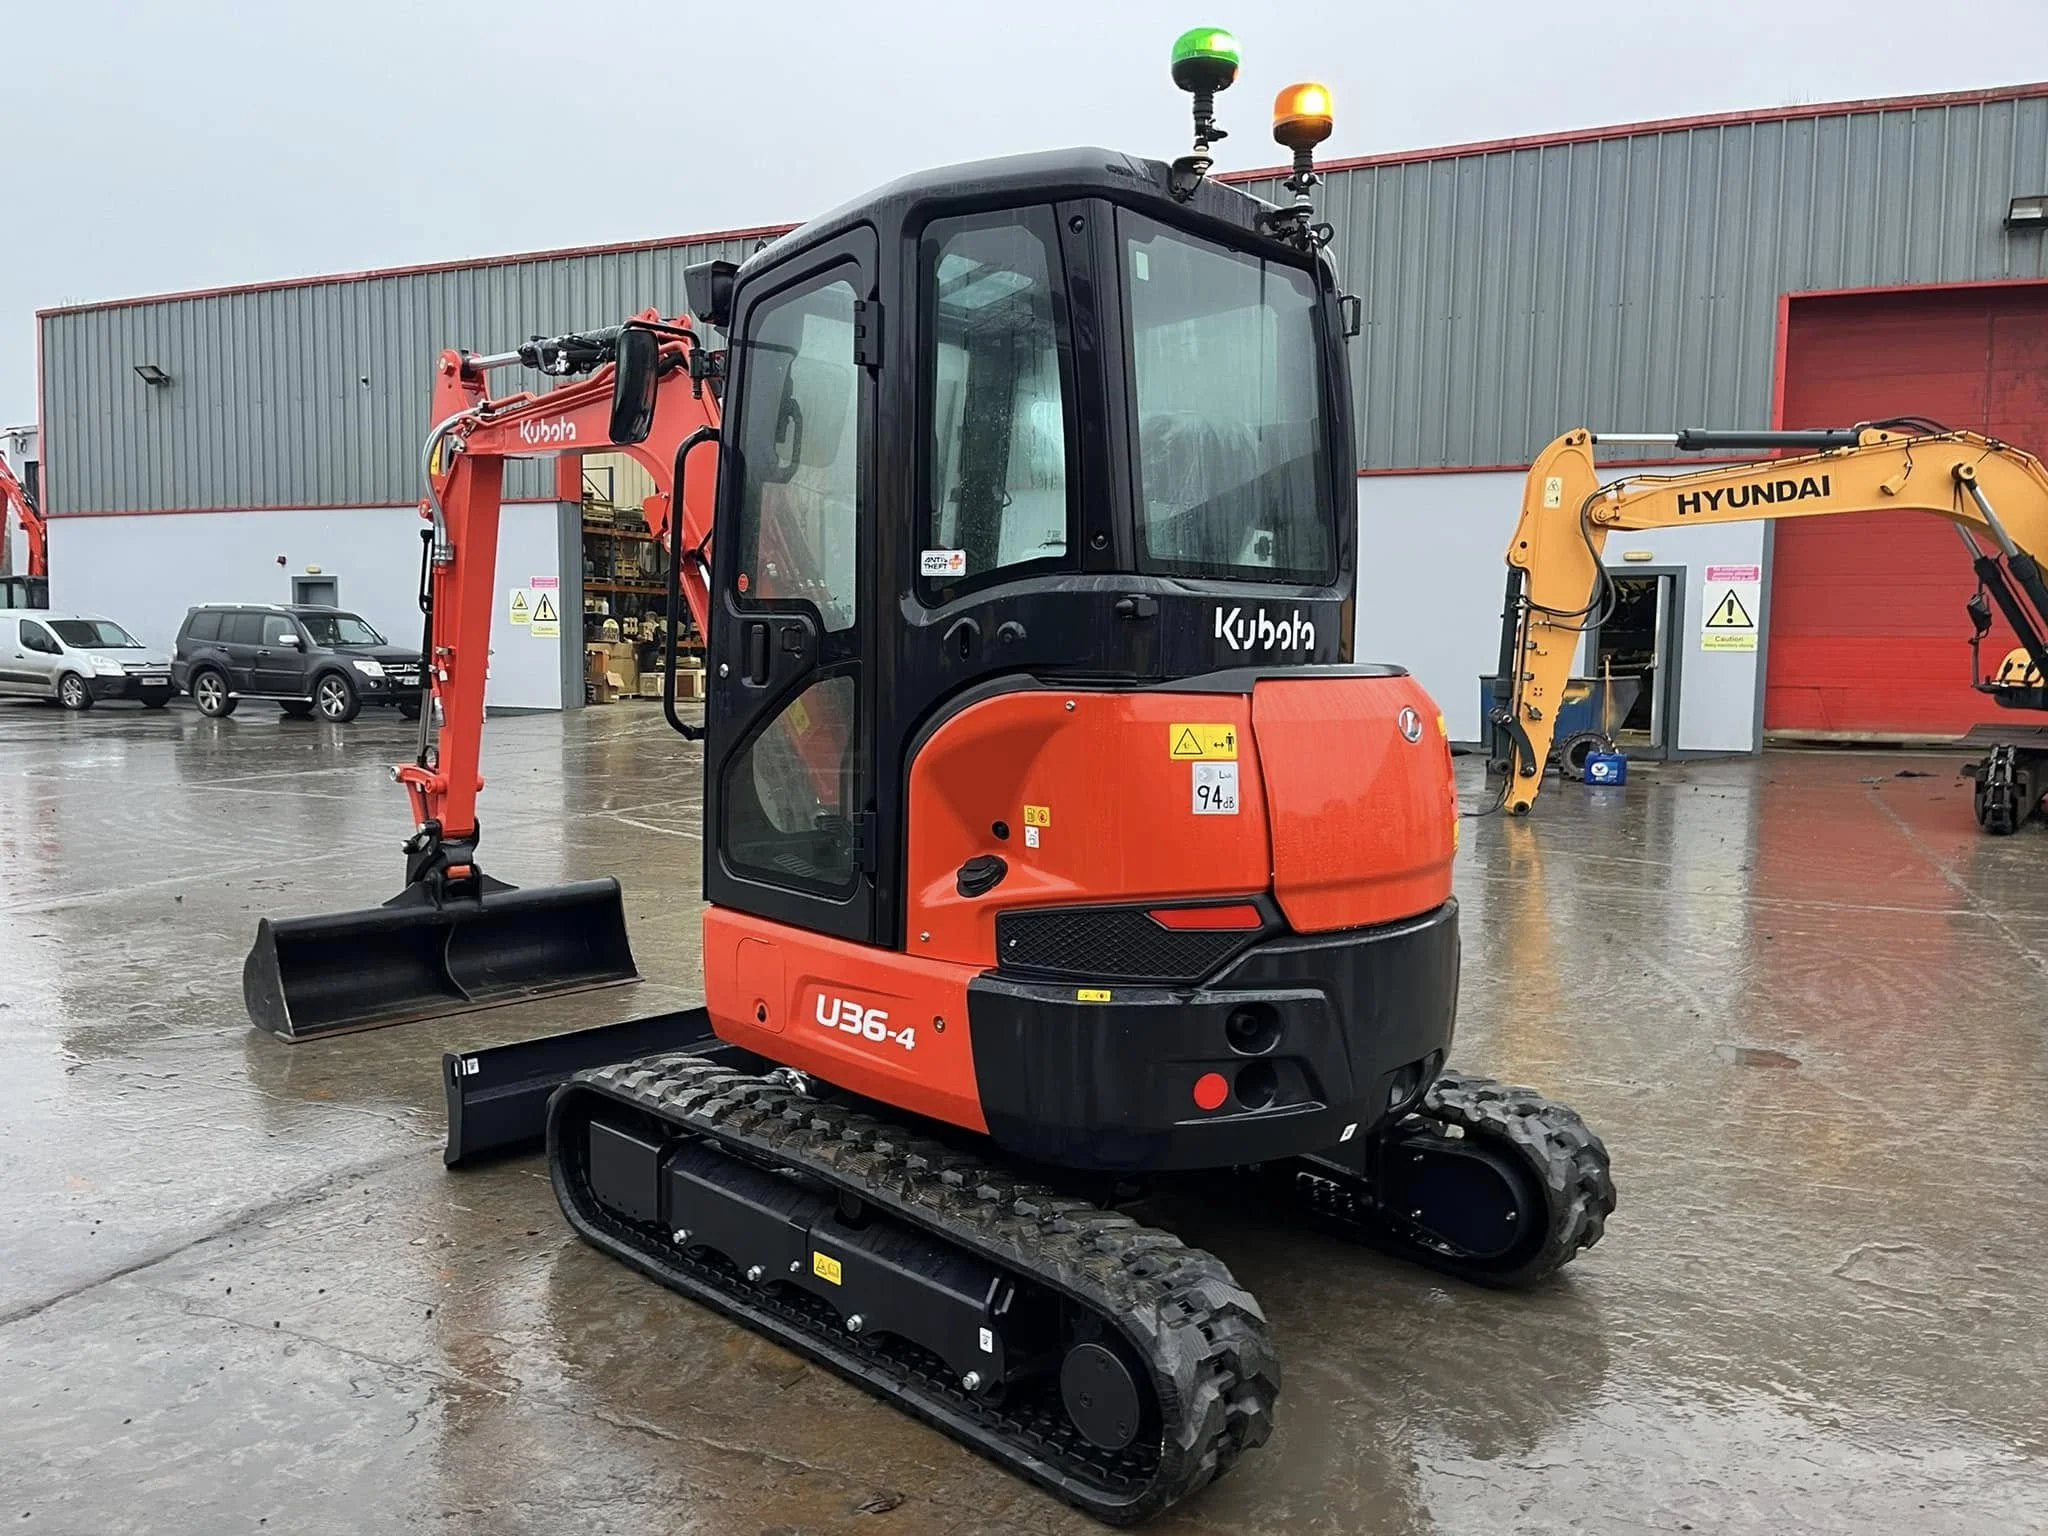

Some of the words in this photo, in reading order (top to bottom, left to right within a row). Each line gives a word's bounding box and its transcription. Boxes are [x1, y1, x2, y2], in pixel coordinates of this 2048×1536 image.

[520, 416, 576, 444] Kubota
[1677, 475, 1830, 515] HYUNDAI
[1215, 607, 1315, 650] Kubota
[1197, 785, 1222, 810] 94
[1223, 796, 1235, 808] dB
[816, 993, 915, 1051] U36-4
